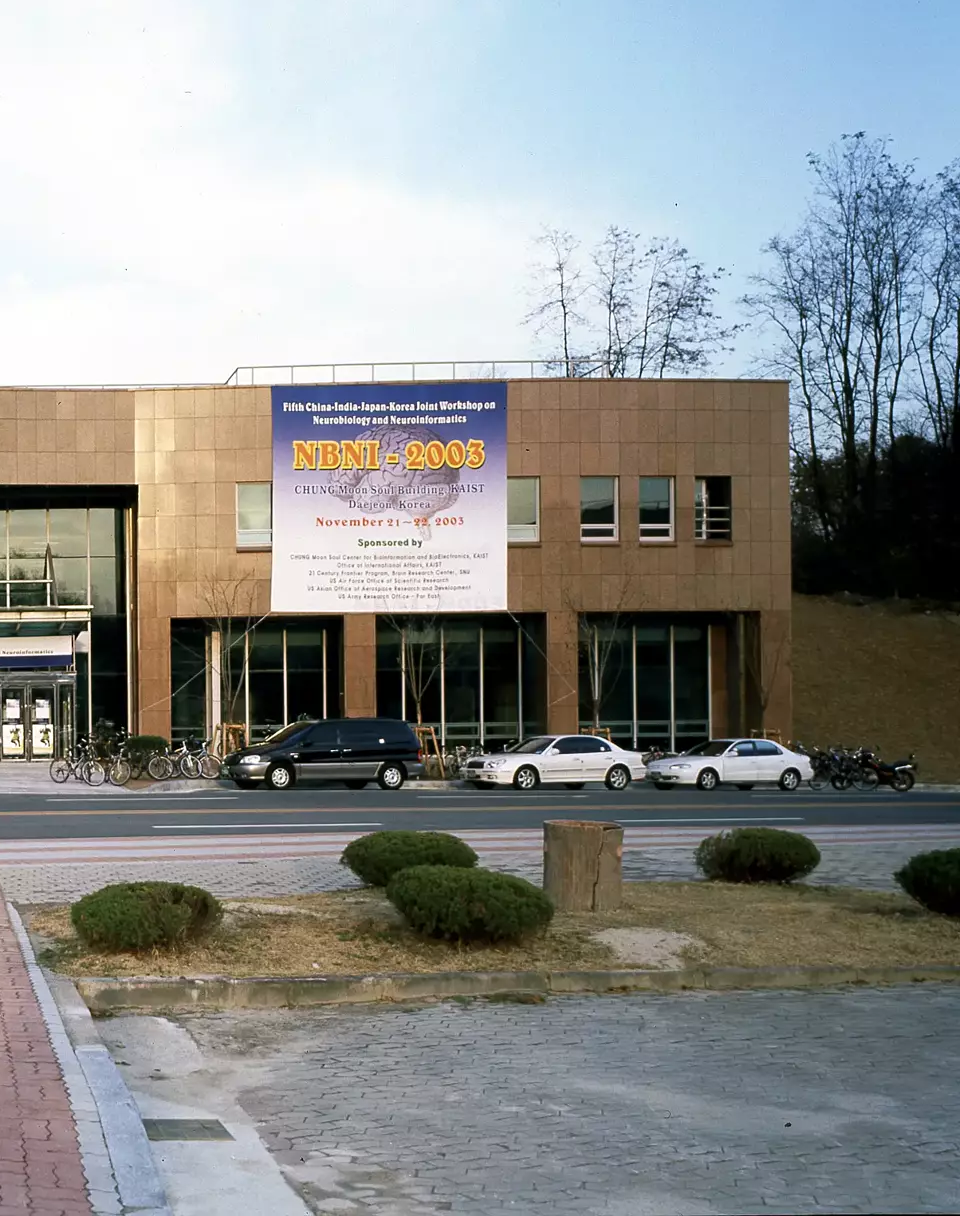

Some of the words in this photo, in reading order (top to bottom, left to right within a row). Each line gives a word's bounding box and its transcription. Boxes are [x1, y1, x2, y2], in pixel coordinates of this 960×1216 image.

[283, 402, 304, 412] Fifth
[416, 401, 438, 411] Joint
[439, 400, 483, 412] Workshop
[484, 401, 496, 409] on
[312, 416, 370, 426] Neurobiology
[372, 416, 389, 424] and
[390, 415, 467, 424] Neuroinformatics
[292, 440, 380, 470] NBNI
[405, 438, 485, 470] 2003
[294, 485, 335, 494] CHUNG
[339, 485, 368, 494] Moon
[371, 485, 394, 494] Soul
[451, 484, 485, 493] KAIST
[399, 501, 431, 509] Korea
[316, 517, 383, 527] November
[435, 517, 464, 526] 2003
[358, 538, 409, 548] Sponsored
[411, 539, 423, 548] by
